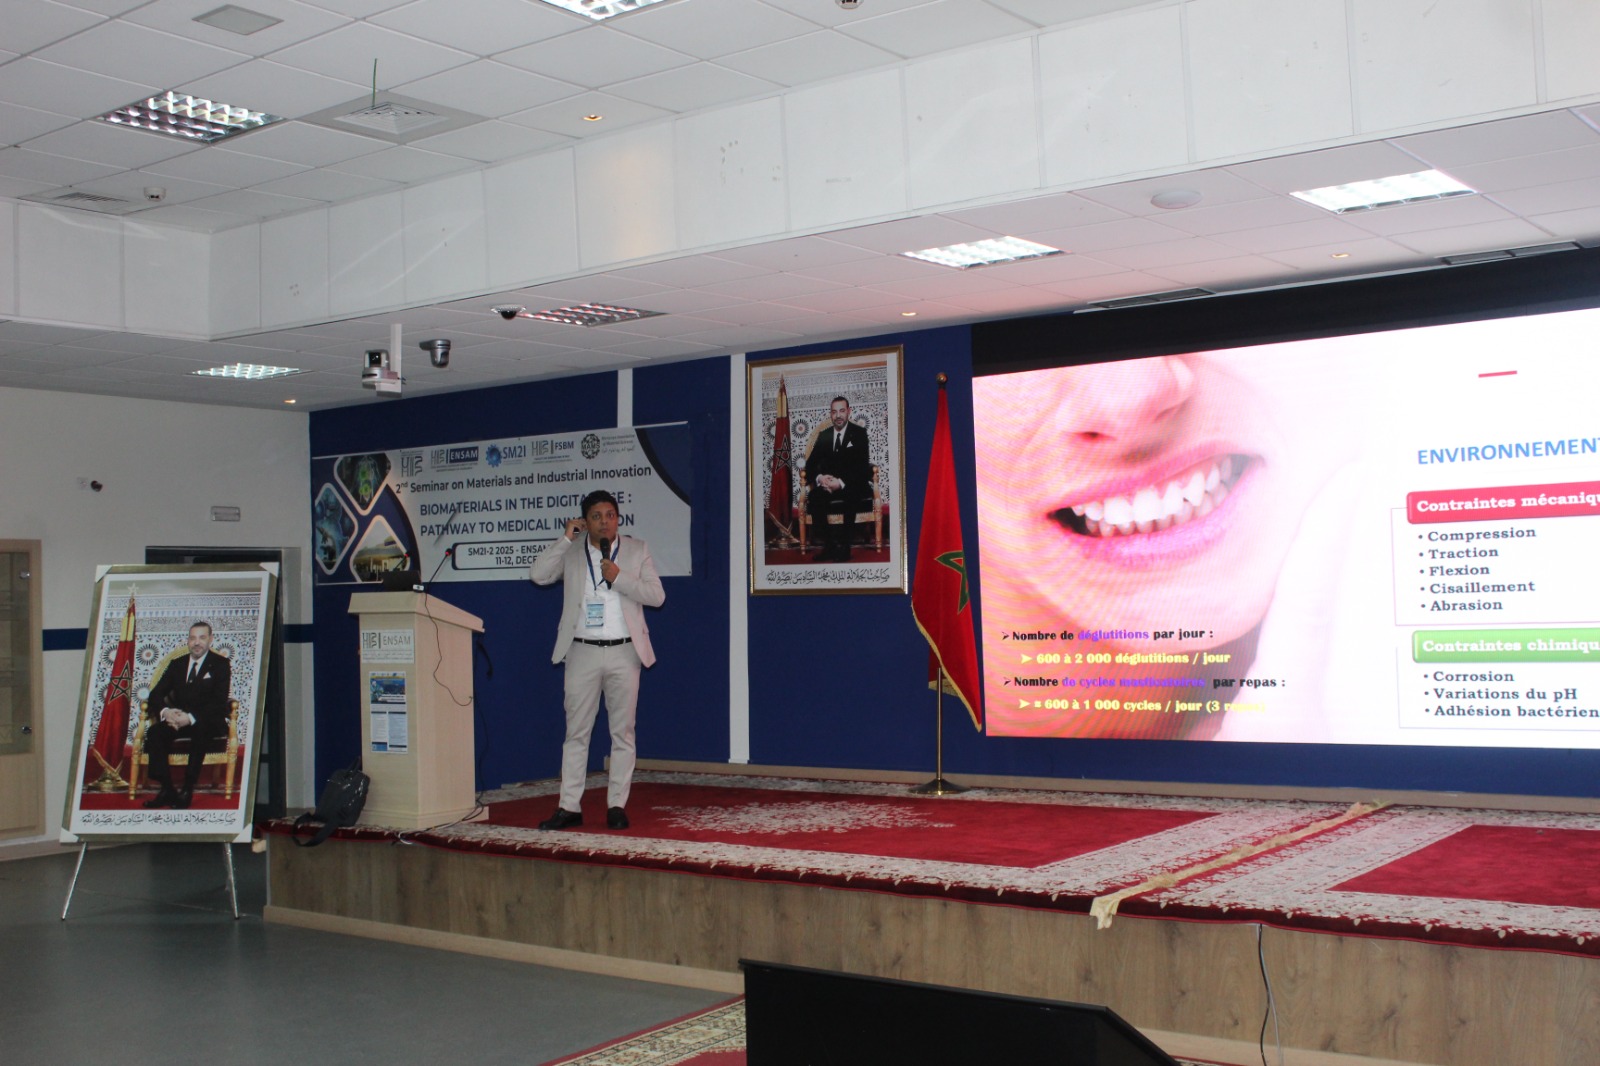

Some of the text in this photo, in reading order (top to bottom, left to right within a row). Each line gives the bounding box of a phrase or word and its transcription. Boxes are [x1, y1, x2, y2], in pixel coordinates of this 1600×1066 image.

[554, 440, 574, 451] FSBM
[1418, 437, 1600, 465] ENVIRONNEMEN
[450, 448, 478, 460] ENSAM
[396, 464, 652, 494] 2nd Seminar on Materials and Industrial Innovation
[420, 499, 502, 516] BIOMATERIALS
[505, 498, 517, 510] IN
[520, 496, 544, 510] THE
[547, 493, 587, 508] DIGITA
[1416, 496, 1516, 512] Contraintes
[420, 522, 476, 536] PATHWAY
[479, 521, 494, 533] TO
[497, 518, 551, 532] MEDICAL
[1427, 527, 1537, 543] Compression
[495, 546, 514, 555] 2025
[1428, 547, 1499, 559] Traction
[1429, 564, 1490, 576] Flexion
[1430, 581, 1536, 594] Cisaillement
[1430, 599, 1503, 611] Abrasion
[383, 635, 411, 646] ENSAM
[1012, 631, 1057, 641] Nombre
[1060, 630, 1074, 640] de
[1078, 629, 1150, 641] déglutitions
[1153, 630, 1174, 641] par
[1178, 628, 1205, 640] jour
[1422, 640, 1522, 652] Contraintes
[1036, 653, 1061, 664] 600
[1063, 653, 1072, 664] à
[1074, 653, 1083, 664] 2
[1086, 653, 1112, 664] 000
[1115, 653, 1189, 666] déglutitions
[1202, 652, 1231, 665] jour
[1014, 677, 1058, 687] Nombre
[1062, 677, 1076, 687] de
[1079, 677, 1116, 688] cycles
[1213, 678, 1236, 689] par
[1239, 678, 1277, 689] repas
[1433, 671, 1515, 682] Corrosion
[1433, 687, 1578, 703] Variations du pH
[1044, 699, 1069, 710] 600
[1072, 699, 1080, 710] à
[1083, 700, 1090, 710] 1
[1094, 700, 1120, 710] 000
[1123, 699, 1162, 712] cycles
[1175, 700, 1203, 712] jour
[1206, 700, 1220, 713] (3
[1434, 704, 1600, 718] Adhésion bactérien
